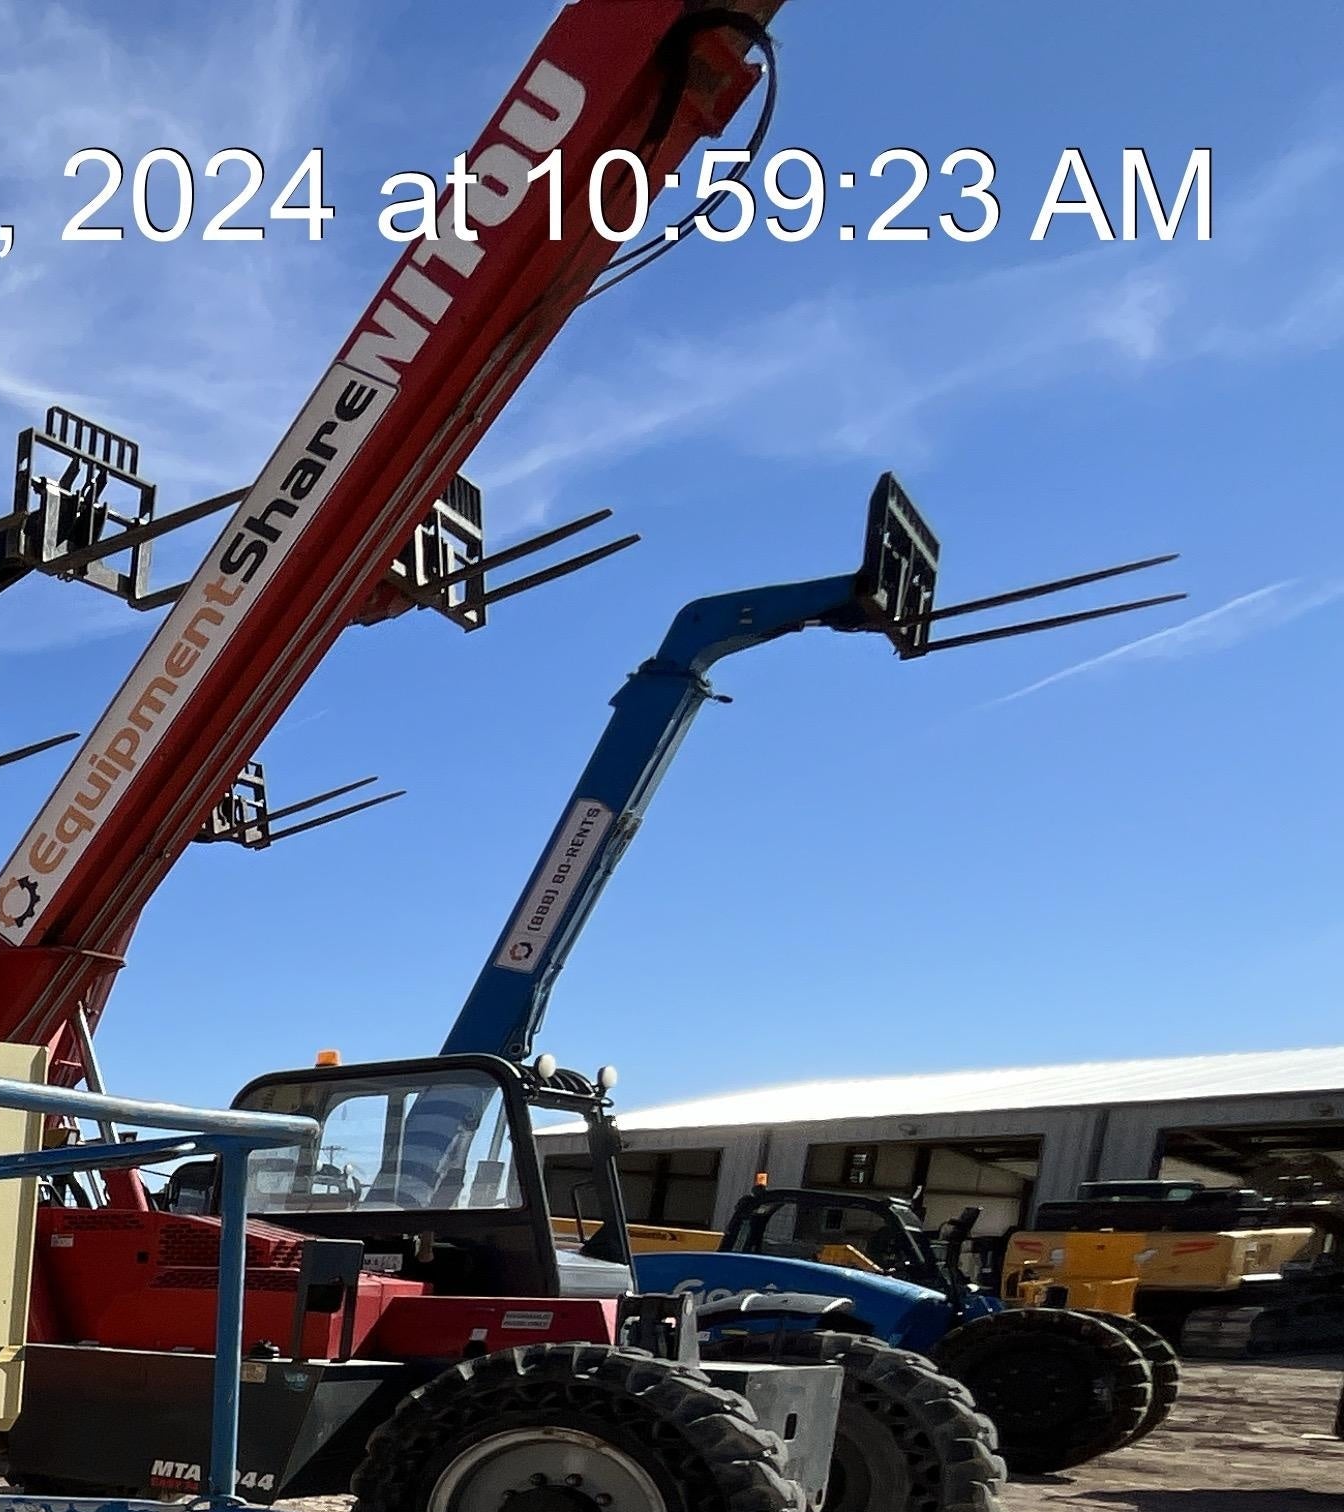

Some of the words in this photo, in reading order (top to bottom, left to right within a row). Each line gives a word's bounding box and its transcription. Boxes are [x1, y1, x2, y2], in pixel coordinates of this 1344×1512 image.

[340, 58, 586, 384] NITOU
[29, 380, 379, 875] EquipmentShare
[150, 1459, 201, 1481] MTA
